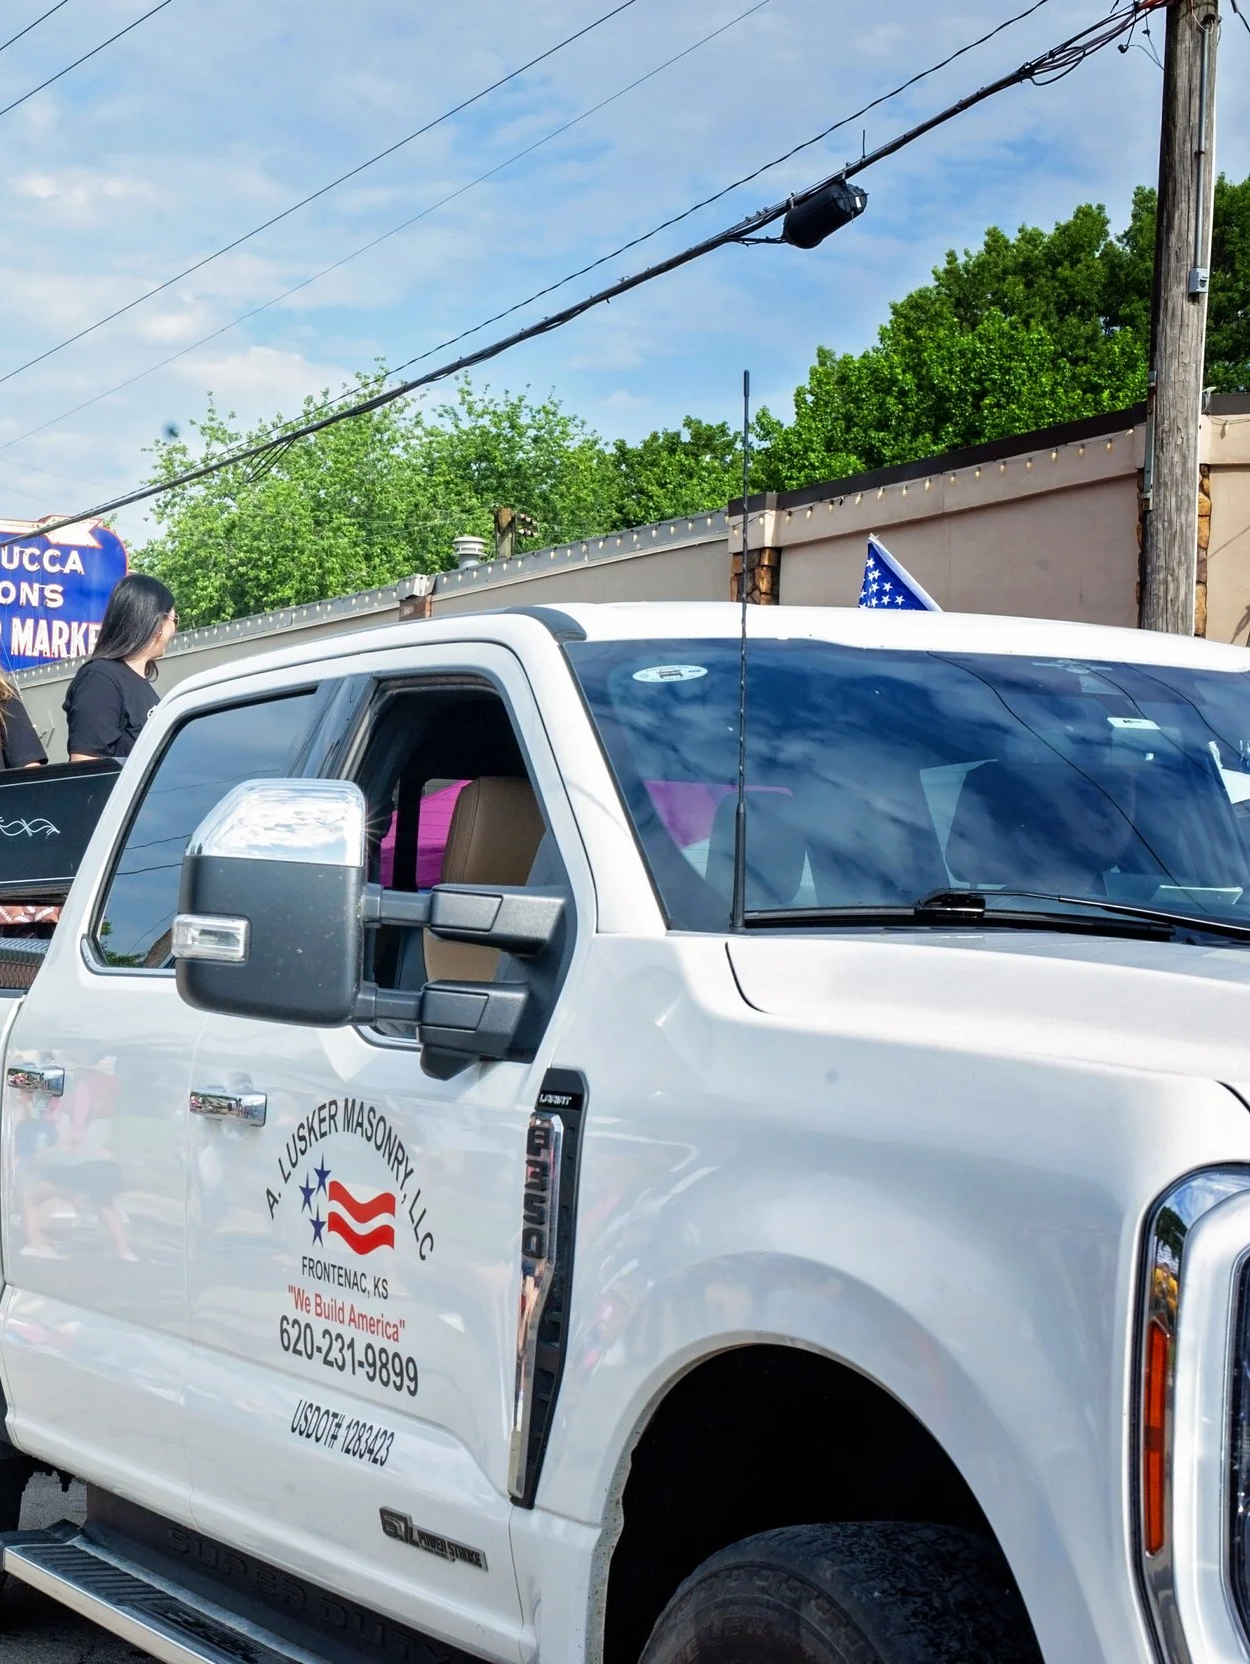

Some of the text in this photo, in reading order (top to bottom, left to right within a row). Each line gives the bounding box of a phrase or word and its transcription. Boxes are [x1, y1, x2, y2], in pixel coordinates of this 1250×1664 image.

[11, 617, 102, 659] MARKE
[265, 1097, 435, 1262] A. LUSKER MASONRY, LLC
[301, 1255, 389, 1300] FRONTENAC, KS
[287, 1284, 406, 1343] "We Build America"
[279, 1314, 419, 1397] 620-231-9899
[290, 1399, 396, 1467] USDOT# 1283423
